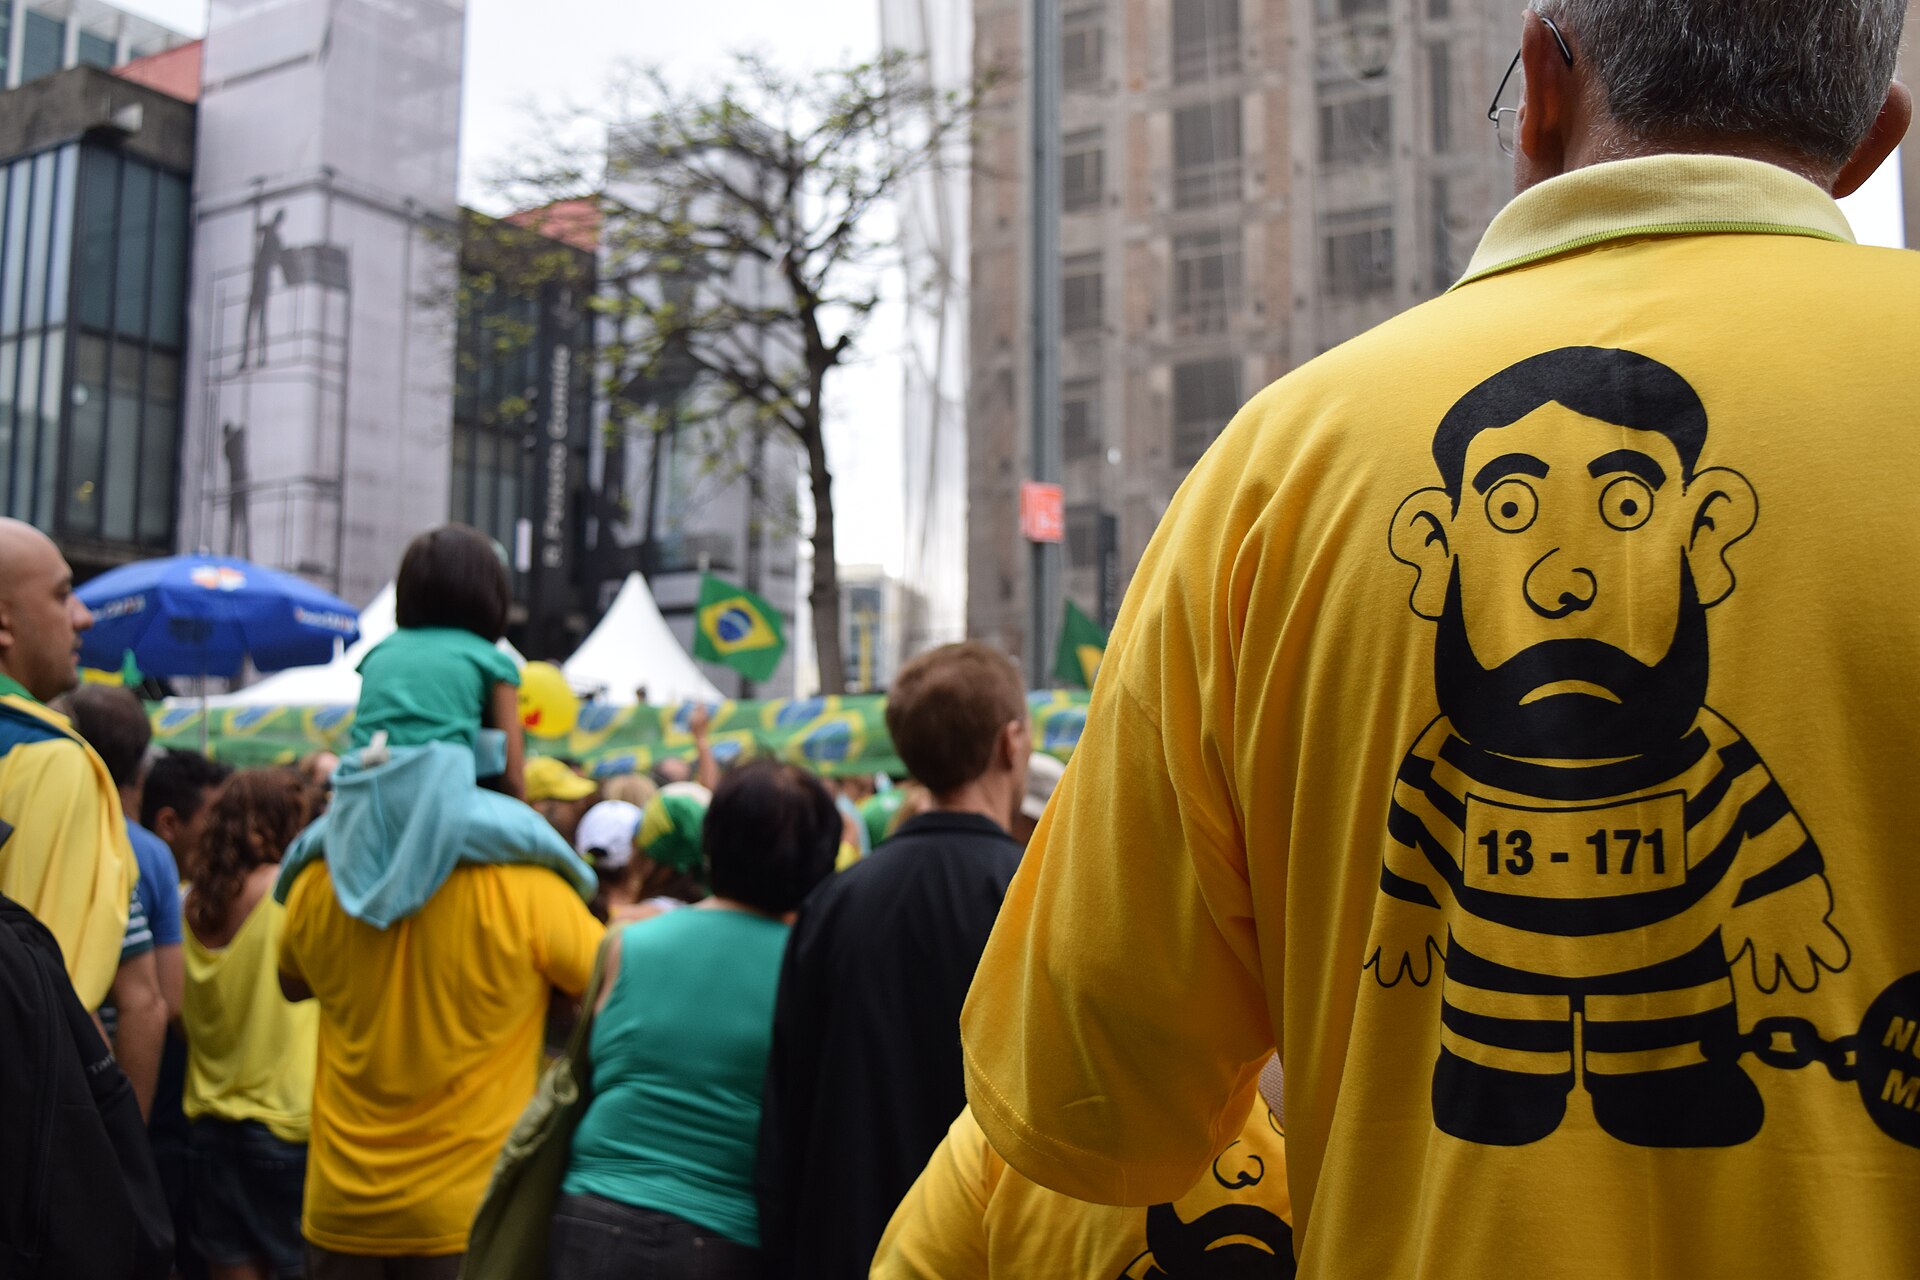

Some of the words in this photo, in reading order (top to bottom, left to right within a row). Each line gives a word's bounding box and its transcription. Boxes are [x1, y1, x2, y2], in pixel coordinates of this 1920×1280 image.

[1478, 829, 1534, 875] 13
[1550, 852, 1569, 862] -
[1586, 828, 1665, 875] 171
[1881, 1015, 1920, 1060] N
[1880, 1068, 1920, 1113] M
